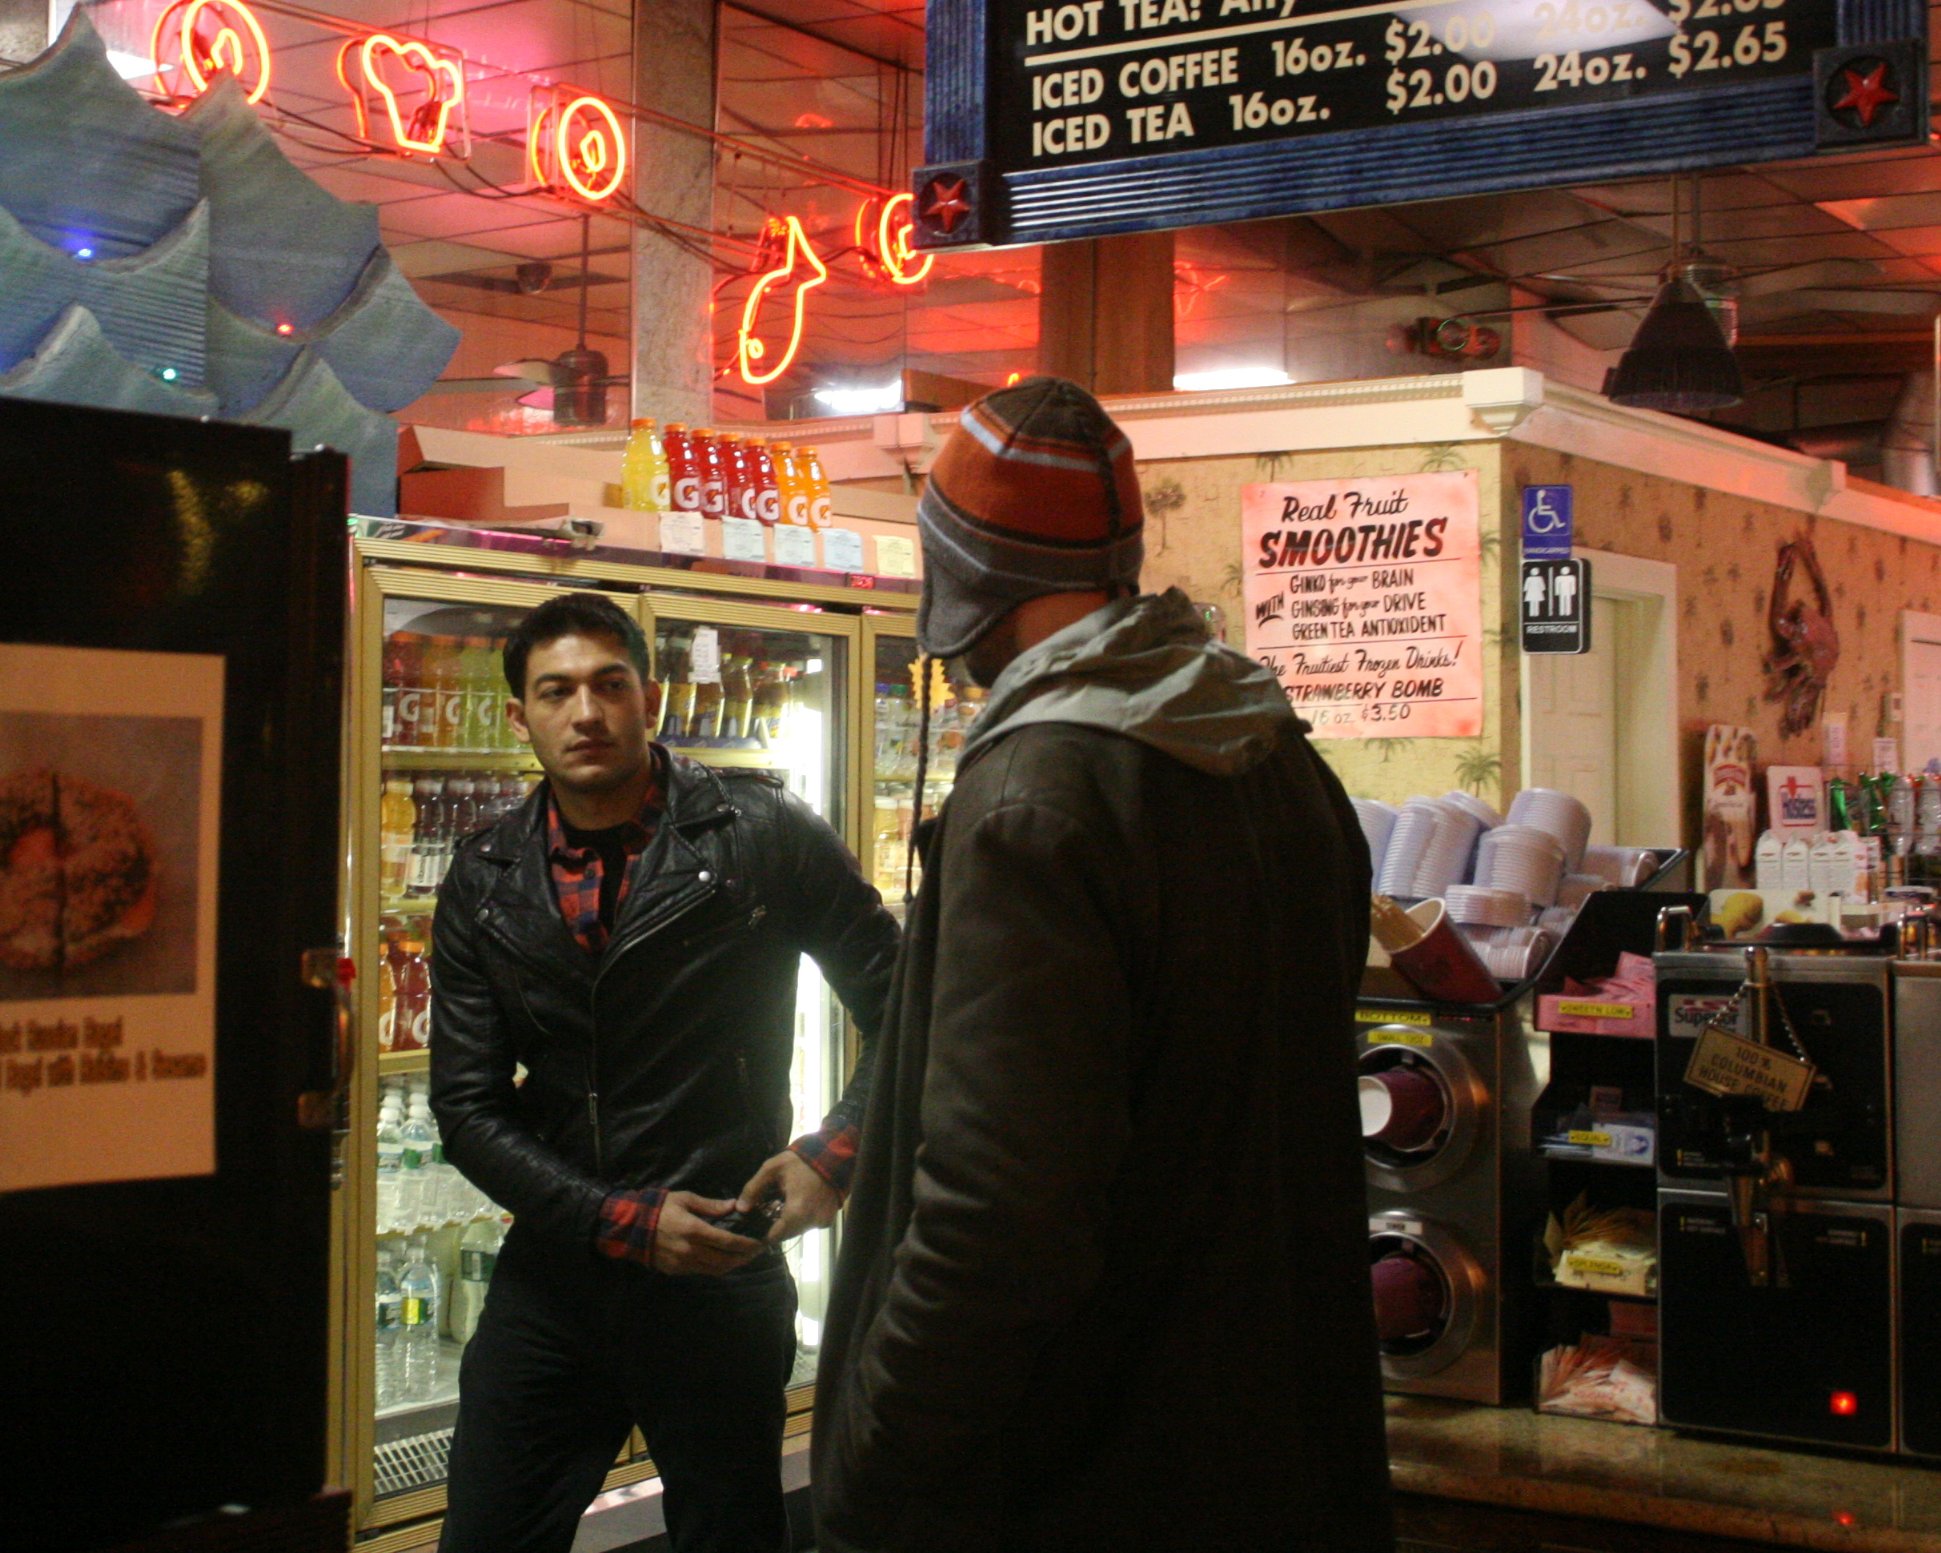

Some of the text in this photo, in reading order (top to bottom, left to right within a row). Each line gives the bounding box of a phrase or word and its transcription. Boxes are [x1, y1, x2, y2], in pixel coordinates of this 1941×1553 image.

[1026, 1, 1103, 46] HOT
[1118, 0, 1200, 31] TEA:
[1032, 68, 1104, 111] ICED
[1119, 47, 1239, 98] COFFEE
[1271, 38, 1366, 77] 16oz.
[1384, 10, 1495, 65] $2.00
[1032, 20, 1787, 156] ICED TEA 16oz. $2.00 24oz. $2.65
[674, 477, 700, 509] G
[702, 481, 724, 513] G
[756, 489, 779, 521] G
[1281, 488, 1408, 523] Real Fruit
[788, 495, 809, 525] G
[810, 497, 832, 527] G
[1259, 516, 1448, 569] SMOOTHIES
[1290, 574, 1326, 594] GINKO
[1372, 568, 1414, 589] BRAIN
[1255, 592, 1285, 619] WITH
[1383, 591, 1427, 613] DRIVE
[1292, 622, 1328, 641] GREEN
[1331, 621, 1355, 638] TEA
[1526, 625, 1577, 634] RESTROOM
[1355, 649, 1401, 678] Frozen
[1405, 640, 1463, 669] Drinks!
[1284, 678, 1444, 702] STRAWBERRY BOMB
[399, 693, 420, 722] G
[1361, 703, 1411, 723] $3.50
[1736, 1046, 1759, 1065] 100
[1711, 1054, 1787, 1092] COLUMBIAN
